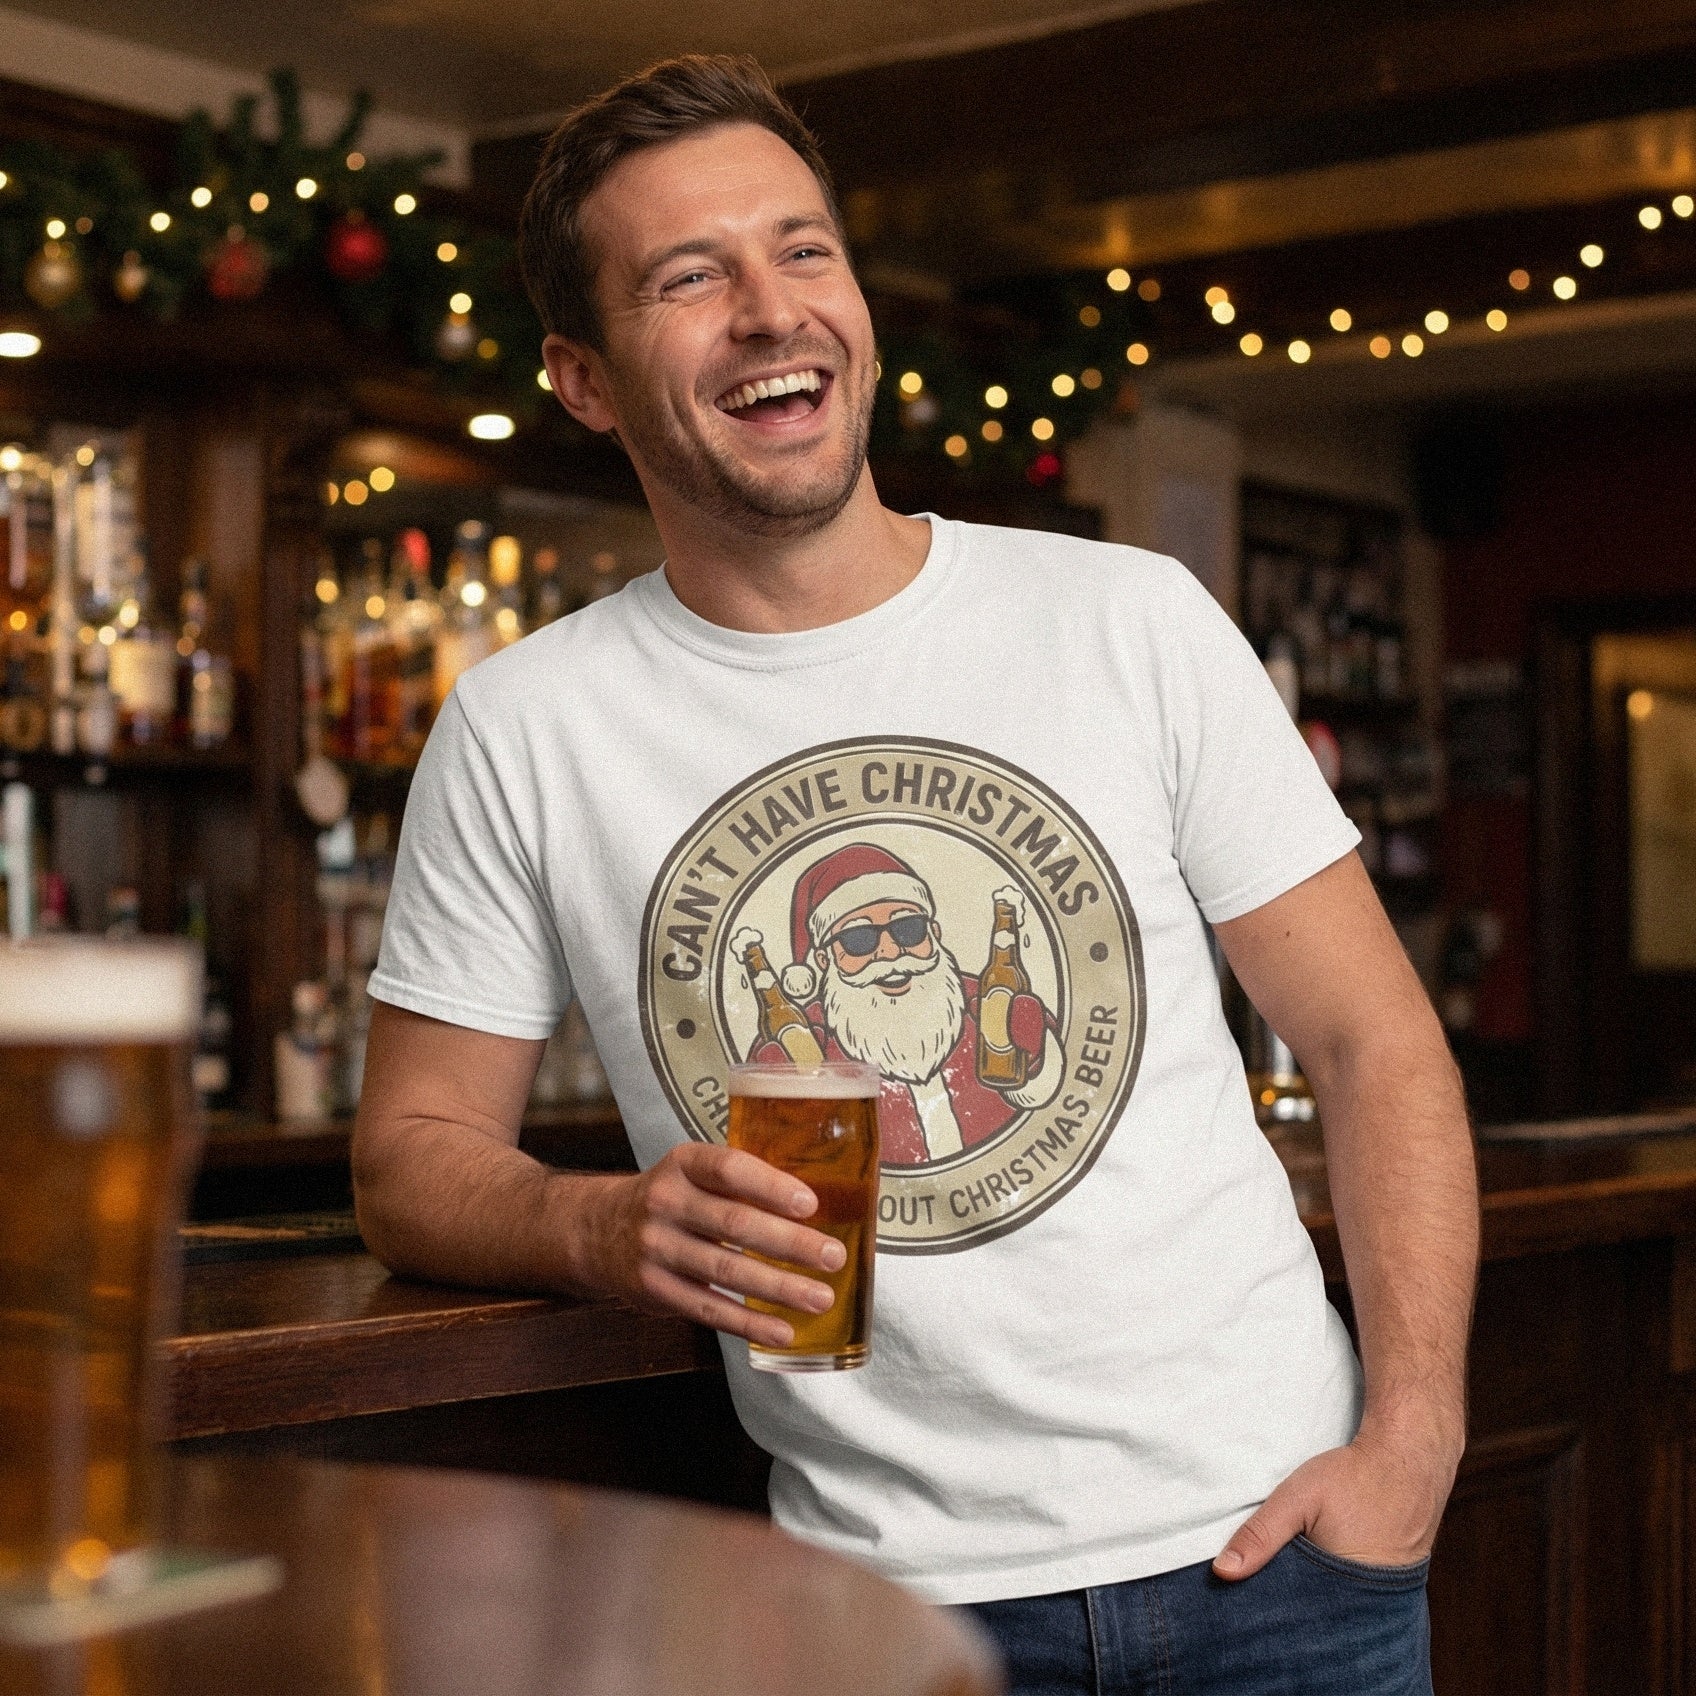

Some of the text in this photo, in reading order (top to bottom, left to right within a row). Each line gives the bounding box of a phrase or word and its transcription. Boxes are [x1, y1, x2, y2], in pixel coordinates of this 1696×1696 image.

[662, 762, 1098, 981] CAN'T HAVE CHRISTMAS
[878, 1195, 935, 1226] OUT
[949, 1094, 1090, 1218] CHRISTMAS
[1074, 1003, 1118, 1087] BEER
